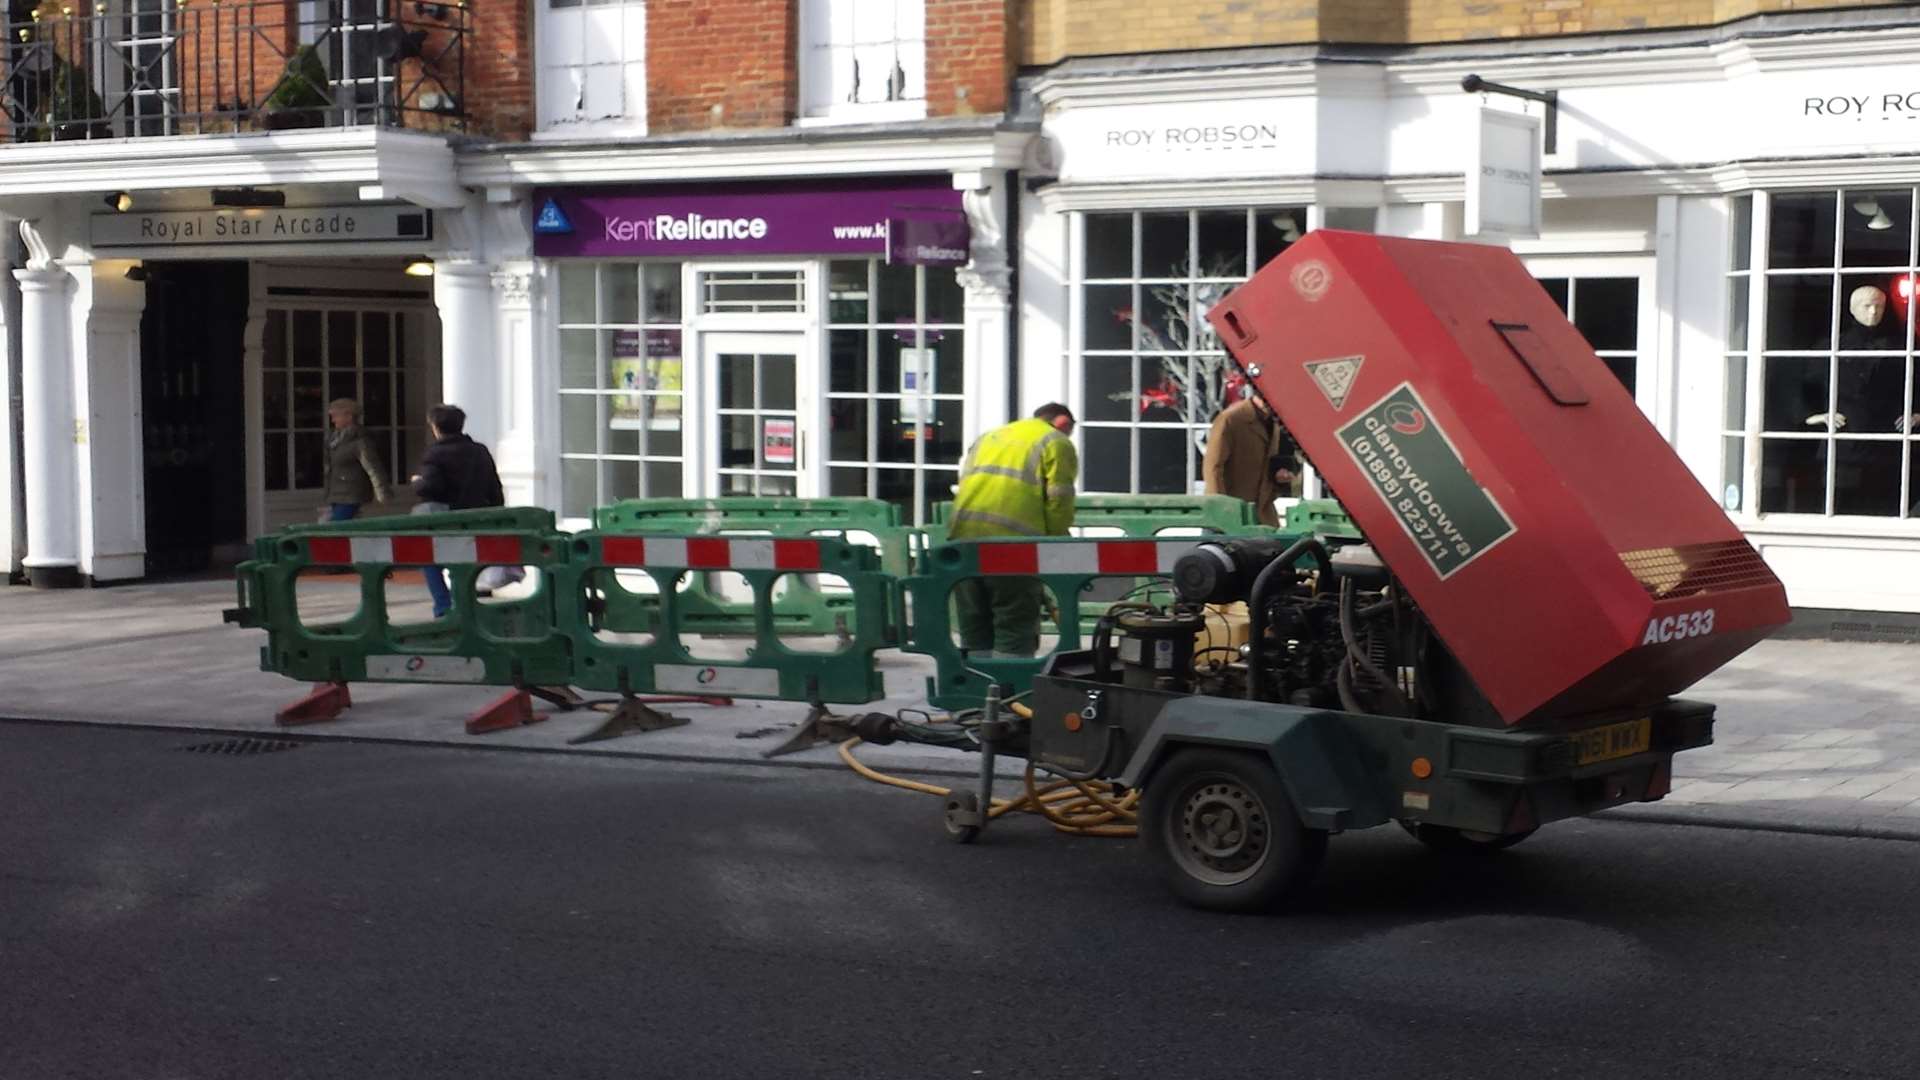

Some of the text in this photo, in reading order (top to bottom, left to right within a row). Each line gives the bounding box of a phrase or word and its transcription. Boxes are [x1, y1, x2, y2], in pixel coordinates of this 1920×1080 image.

[1804, 95, 1870, 116] ROY
[1106, 124, 1277, 146] ROY ROBSON
[141, 214, 356, 241] Royal Star Arcade
[1351, 435, 1449, 560] (01895) 823711
[1364, 416, 1471, 556] clancydocwra
[1642, 608, 1715, 646] AC533
